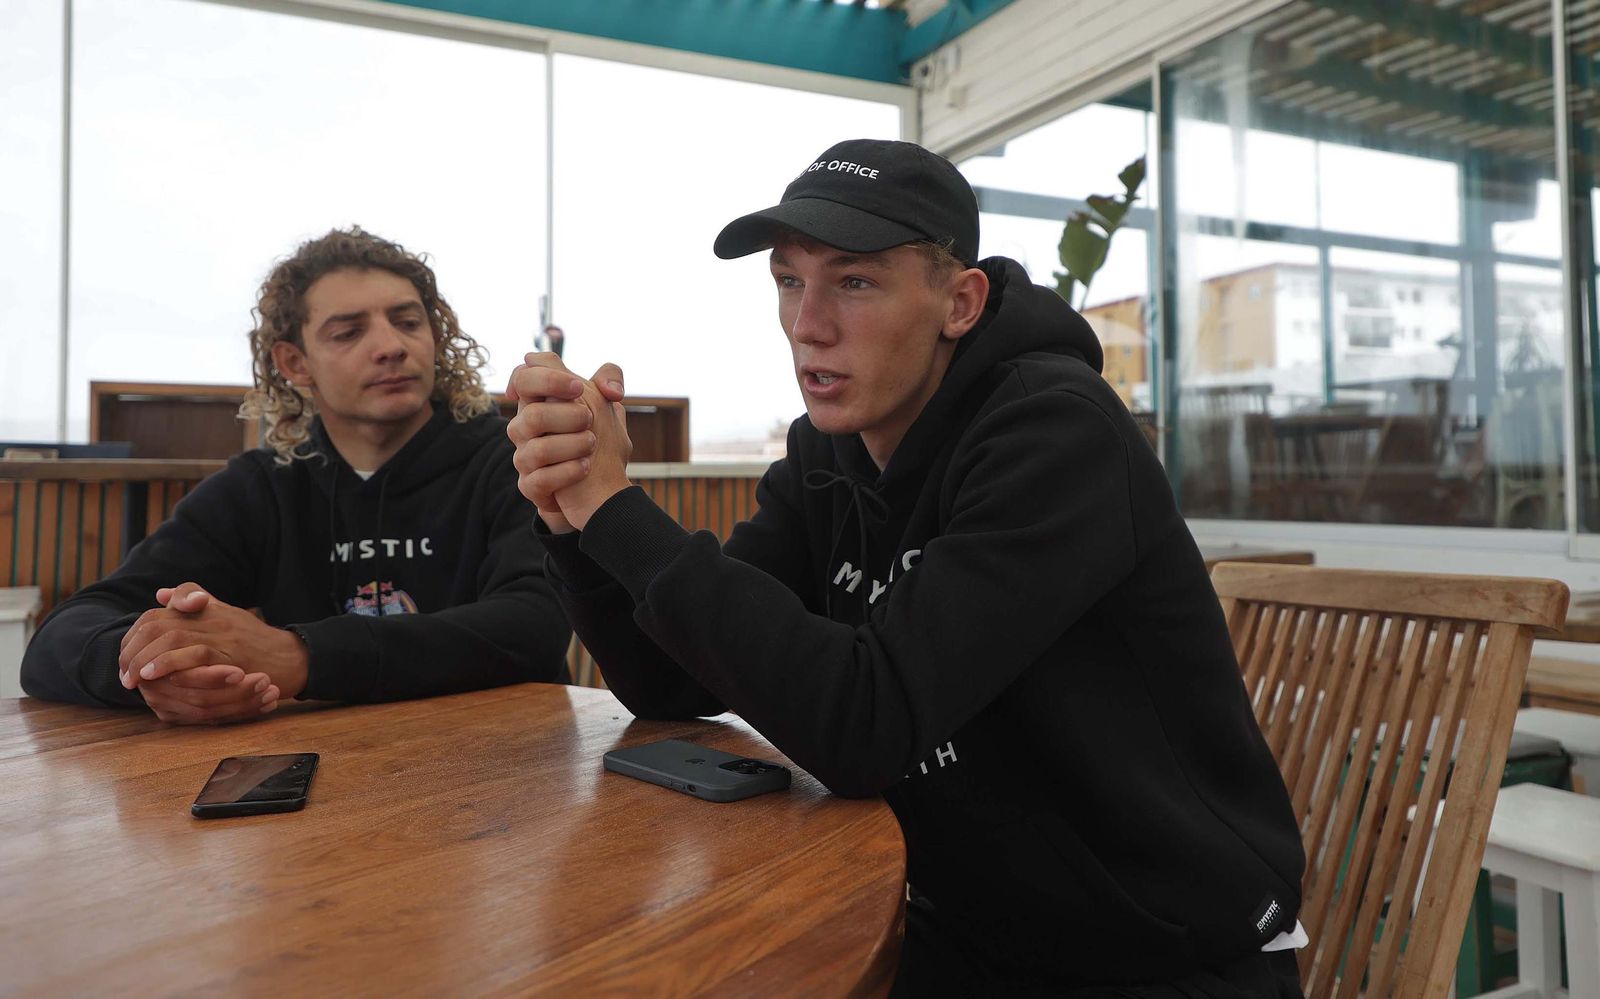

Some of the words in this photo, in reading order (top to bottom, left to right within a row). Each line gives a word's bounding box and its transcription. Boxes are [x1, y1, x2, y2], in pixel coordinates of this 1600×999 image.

[808, 161, 826, 173] OF
[827, 160, 880, 180] OFFICE
[329, 537, 433, 562] MSTIC
[1260, 899, 1279, 925] MYSTIC
